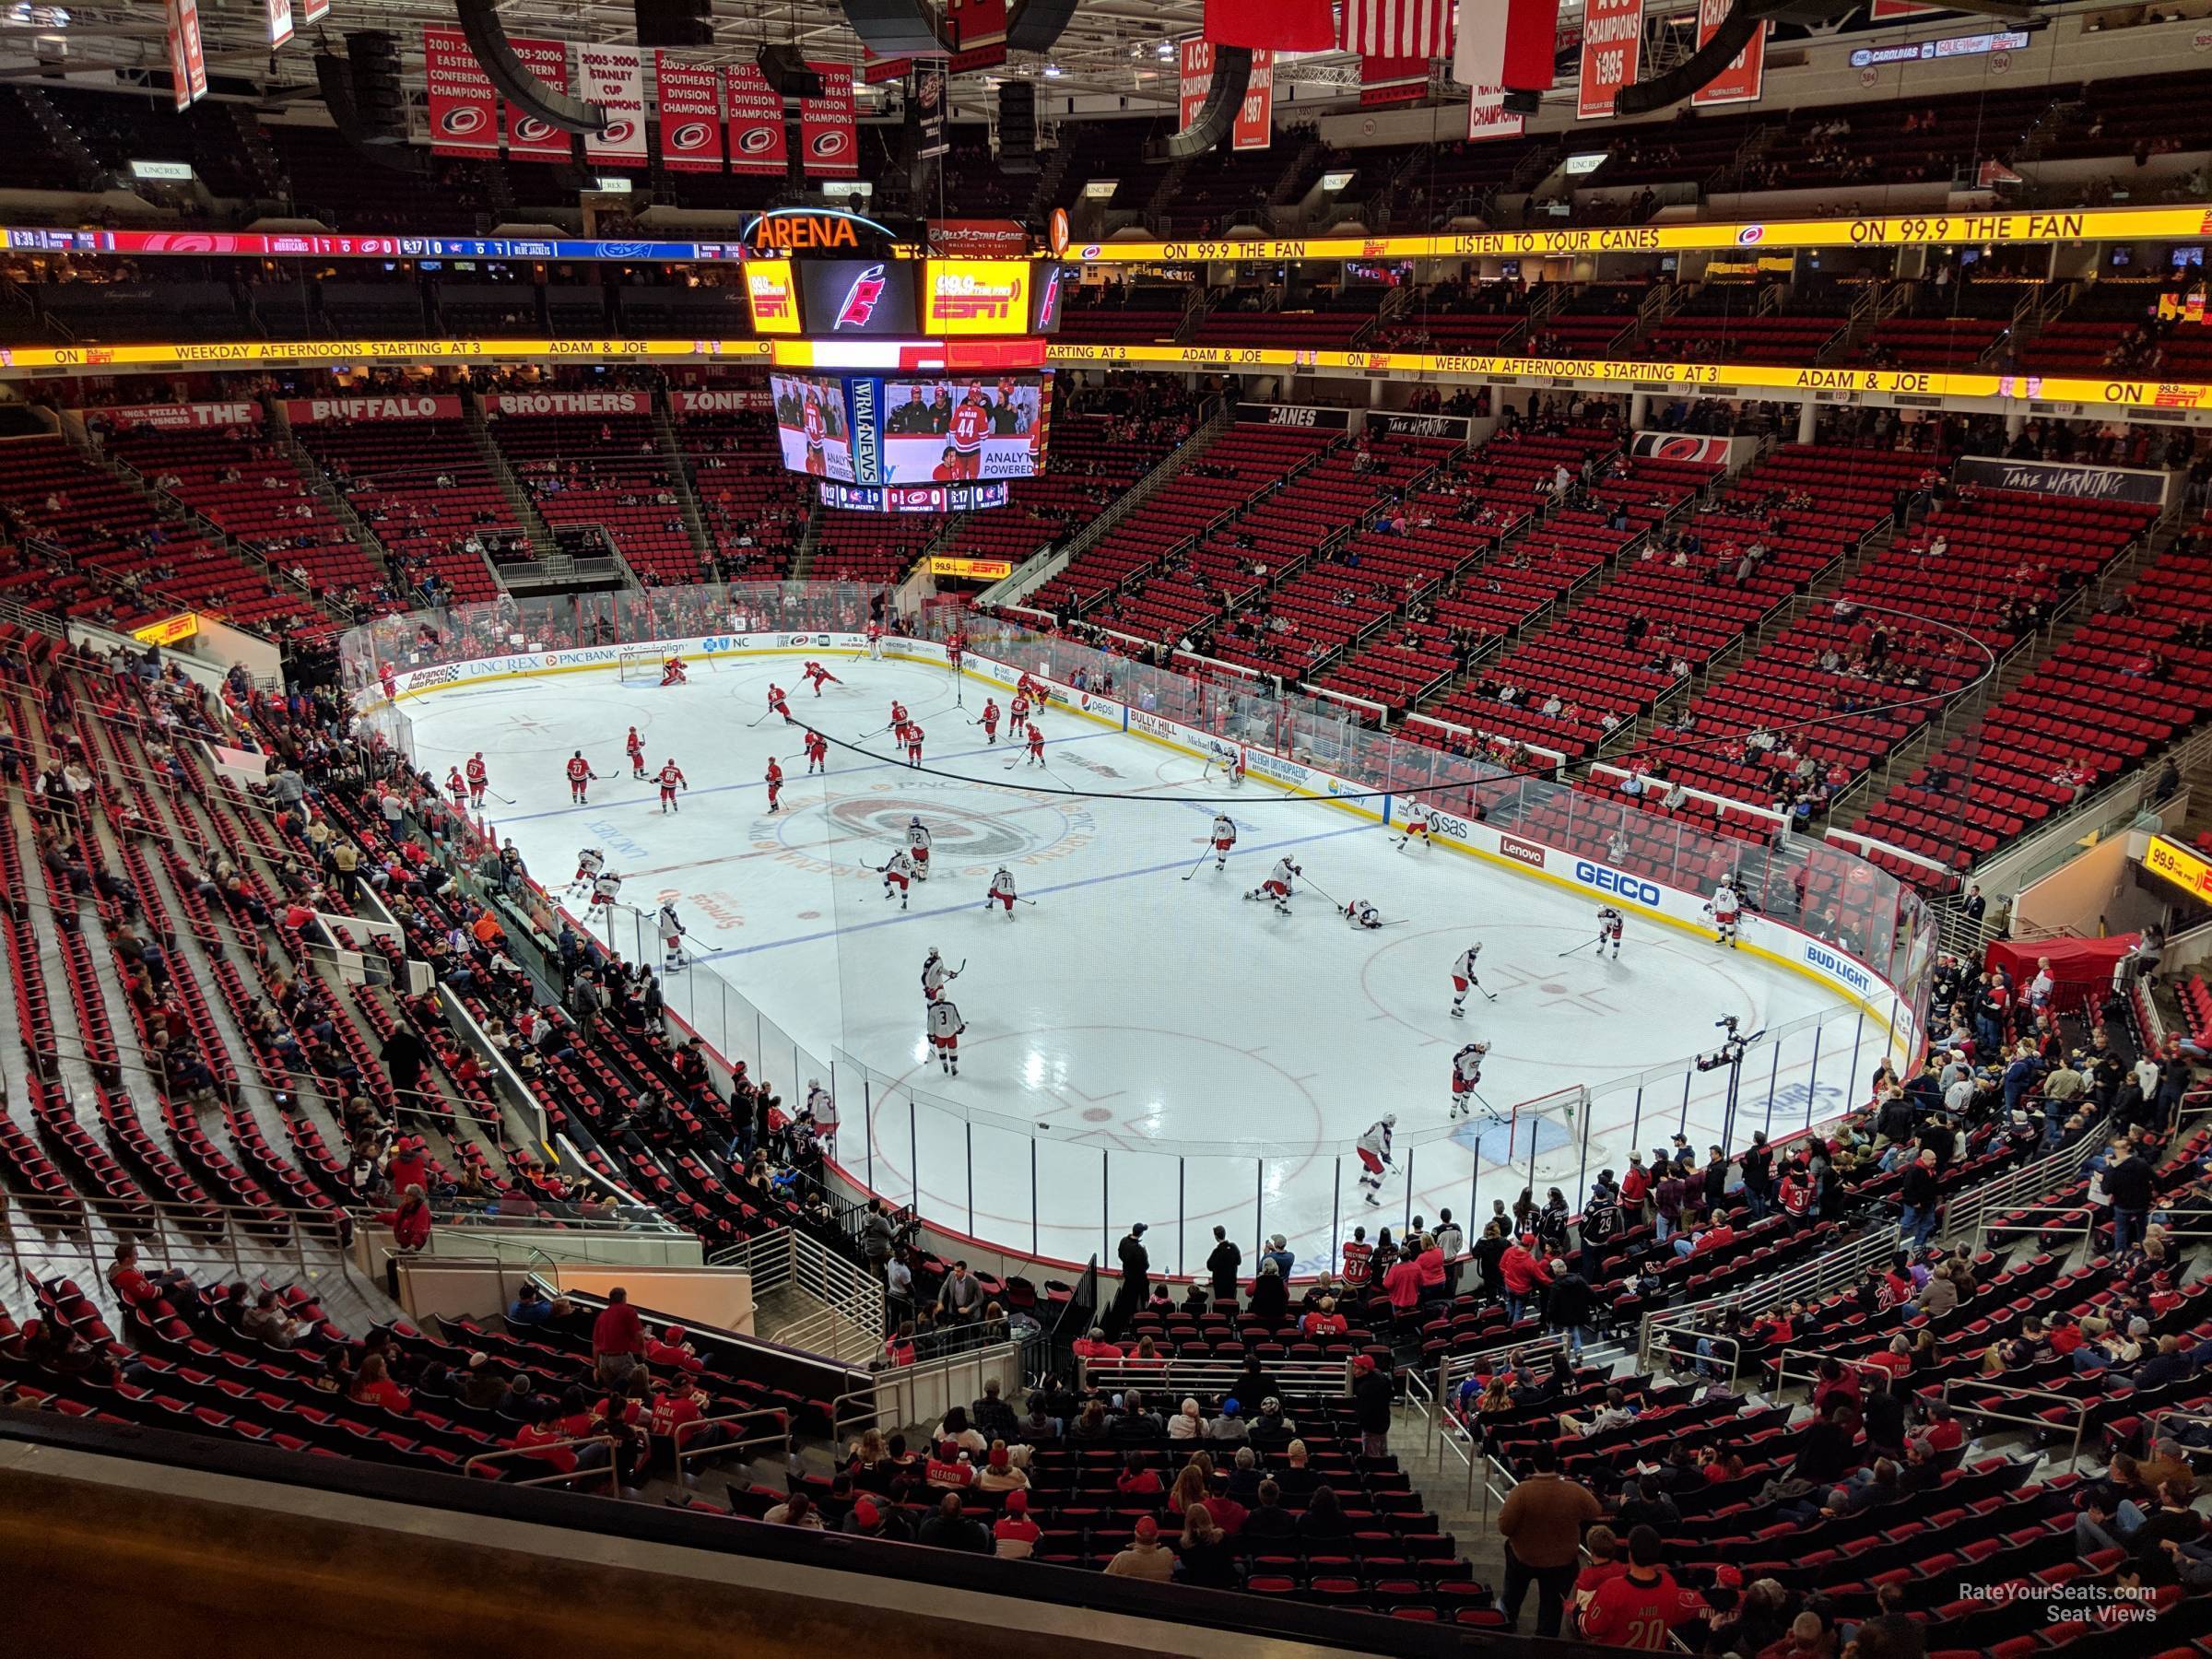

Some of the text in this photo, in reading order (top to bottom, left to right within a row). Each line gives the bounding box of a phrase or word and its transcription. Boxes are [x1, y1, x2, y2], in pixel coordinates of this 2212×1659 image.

[1586, 13, 1639, 44] CHAMPIONS
[582, 53, 640, 68] 2005-2006
[1188, 42, 1208, 71] ACC
[1872, 46, 1918, 62] CAROLINAS
[1595, 49, 1624, 85] 1985
[430, 69, 490, 85] CONFERENCE
[589, 69, 633, 82] STANLEY
[661, 74, 716, 87] SOUTHEAST
[431, 85, 492, 100] CHAMPIONS
[602, 85, 623, 95] CUP
[667, 88, 710, 100] DIVISION
[735, 95, 775, 106] DIVISION
[808, 100, 847, 111] DIVISION
[663, 102, 717, 115] CHAMPIONS
[730, 108, 782, 121] CHAMPIONS
[1244, 95, 1263, 124] 1987
[804, 112, 853, 124] CHAMPIONS
[757, 212, 859, 250] ARENA
[941, 229, 1024, 241] ALL STAR GAME
[1850, 215, 2083, 242] ON 99.9 THE FAN
[15, 232, 34, 246] 6:39
[274, 241, 309, 252] HURRICANES
[404, 241, 422, 251] 6:17
[1454, 229, 1659, 253] LISTEN TO YOUR CANES
[343, 243, 350, 252] 0
[383, 241, 392, 253] 0
[434, 241, 441, 253] 0
[477, 246, 485, 254] 0
[514, 246, 550, 255] BLUE JACKETS
[1163, 241, 1305, 260] ON 99.9 THE FAN
[935, 275, 974, 295] 99.9
[933, 295, 1009, 318] ESPN
[175, 342, 481, 359] WEEKDAY AFTERNOONS STARTING AT 3
[549, 342, 648, 354] ADAM & JOE
[1101, 347, 1126, 359] AT 3
[1182, 348, 1262, 362] ADAM & JOE
[54, 350, 78, 363] ON
[1347, 353, 1364, 367] ON
[1435, 357, 1717, 382] WEEKDAY AFTERNOONS STARTING AT 3
[1796, 371, 1929, 391] ADAM & JOE
[2104, 382, 2144, 402] ON
[2158, 384, 2180, 394] 99.9
[499, 394, 636, 414] BROTHERS
[682, 392, 747, 411] ZONE
[2154, 394, 2198, 406] ESPN
[148, 408, 177, 417] PIZZA
[192, 404, 253, 425] THE
[312, 397, 436, 420] BUFFALO
[1268, 406, 1317, 427] CANES
[808, 418, 818, 433] 44
[853, 381, 876, 482] WRAL NEWS
[957, 418, 975, 438] 44
[1388, 416, 1451, 441] TAKE WARNING
[829, 465, 854, 480] POWERED
[984, 465, 1033, 475] POWERED
[2001, 466, 2126, 497] TAKE WARNING
[840, 488, 847, 501] 0
[931, 490, 940, 504] 0
[951, 489, 968, 503] 6:17
[976, 488, 983, 501] 0
[935, 561, 951, 571] 99.9
[972, 561, 1006, 574] ESPN
[168, 617, 193, 636] ESPN
[733, 638, 749, 649] NC
[470, 656, 539, 675] UNC REX
[411, 667, 446, 682] Advance
[407, 676, 445, 690] Auto Parts
[1092, 700, 1114, 716] pepsi
[1131, 710, 1177, 736] BULLY HILL
[1138, 724, 1170, 740] VINEYARDS
[1187, 735, 1210, 749] Michael
[468, 765, 477, 775] 57
[573, 764, 582, 773] 27
[1248, 749, 1308, 781] RALEIGH ORTHOPAEDIC
[665, 771, 675, 781] 86
[1441, 817, 1467, 839] sas
[1503, 840, 1540, 863] Lenovo
[2152, 848, 2174, 870] 99.9
[901, 859, 911, 870] 45
[1576, 861, 1660, 906] GEICO
[1807, 947, 1869, 992] BUD LIGHT
[939, 1010, 947, 1025] 3
[796, 1139, 806, 1154] 72
[1794, 1189, 1811, 1206] 37
[1598, 1216, 1612, 1234] 29
[1348, 1260, 1366, 1277] 37
[1316, 1322, 1336, 1331] SLAVIN
[655, 1404, 676, 1418] FAULK
[931, 1468, 960, 1483] GLEASON
[1639, 1606, 1658, 1617] AHO
[1624, 1618, 1665, 1651] 20
